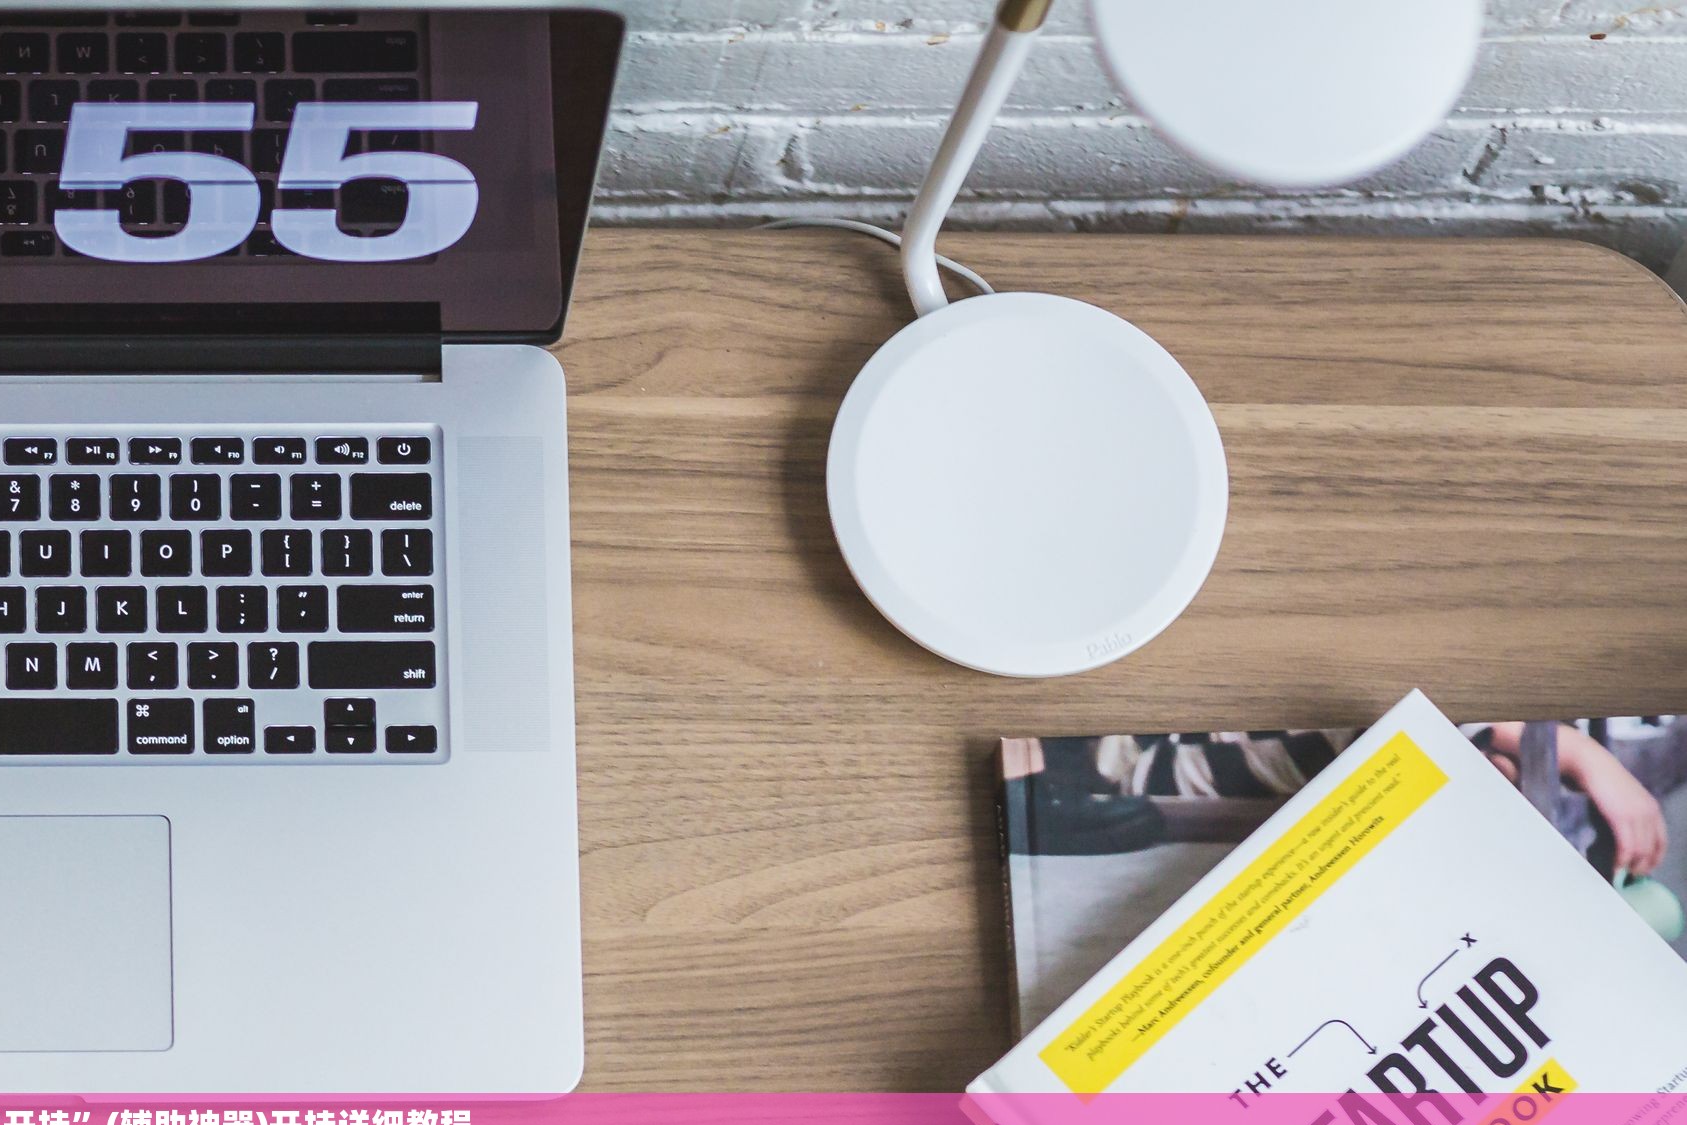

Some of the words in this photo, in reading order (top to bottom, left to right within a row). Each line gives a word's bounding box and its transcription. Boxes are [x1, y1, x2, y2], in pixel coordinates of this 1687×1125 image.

[55, 101, 480, 263] 55
[43, 452, 54, 460] F7
[106, 452, 116, 460] F8
[168, 452, 178, 460] F9
[227, 452, 240, 460] F10
[291, 452, 303, 460] F11
[352, 452, 365, 460] F12
[10, 498, 21, 513] 7
[70, 498, 81, 512] 8
[130, 498, 141, 512] 9
[190, 497, 201, 512] 0
[389, 500, 423, 511] delete
[39, 544, 53, 560] U
[103, 544, 109, 560] I
[159, 544, 173, 559] O
[221, 543, 233, 559] P
[401, 591, 425, 599] enter
[56, 601, 66, 616] J
[116, 600, 129, 616] K
[177, 600, 188, 615] L
[393, 613, 425, 623] return
[25, 657, 39, 673] N
[84, 656, 101, 672] M
[403, 668, 426, 680] shift
[237, 704, 250, 714] alt
[135, 733, 188, 745] command
[216, 734, 250, 747] option
[1199, 941, 1241, 980] cofounder
[1236, 928, 1255, 947] and
[1252, 904, 1284, 935] general
[1307, 842, 1351, 884] Andreessen
[1348, 812, 1385, 847] Horowitz
[1094, 1000, 1124, 1029] Startup
[1120, 971, 1156, 1005] Playbook
[1227, 1055, 1288, 1113] THE
